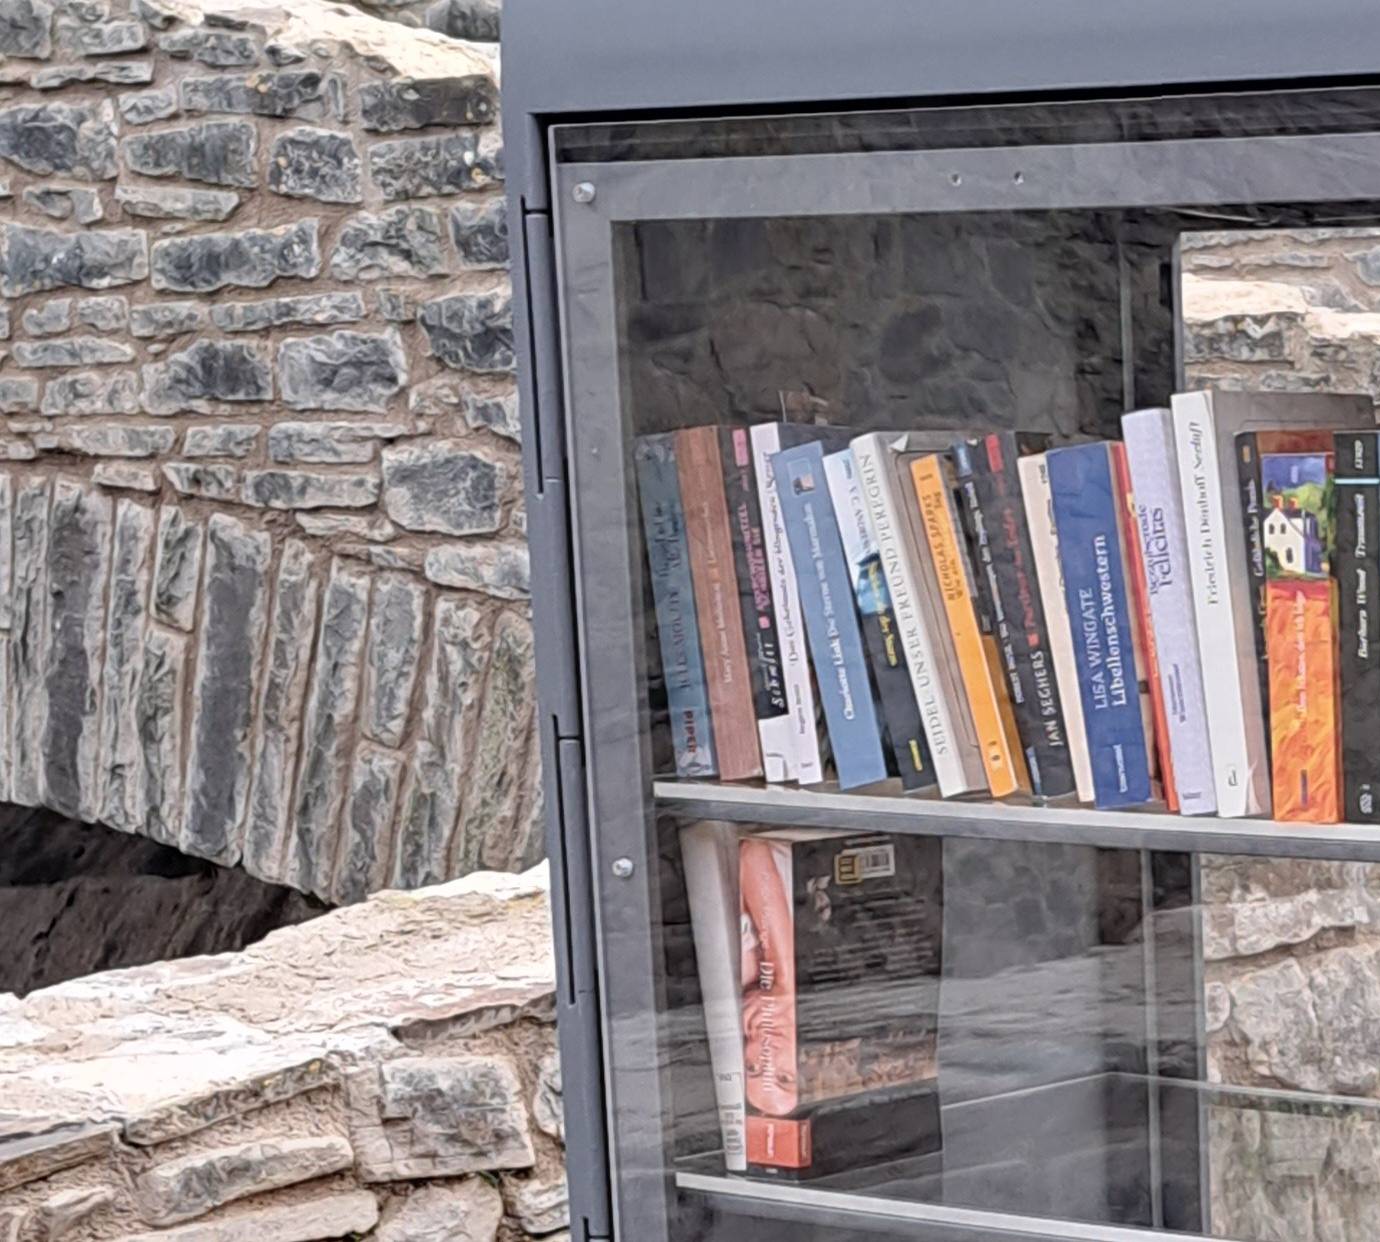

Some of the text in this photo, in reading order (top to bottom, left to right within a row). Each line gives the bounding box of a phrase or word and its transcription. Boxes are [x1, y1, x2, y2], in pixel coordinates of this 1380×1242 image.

[860, 455, 891, 541] PEREGRIN
[886, 548, 913, 620] FREUND
[934, 543, 956, 602] NICHOLAS
[1202, 538, 1218, 604] Friedrich
[1079, 589, 1108, 709] LISA WINGATE
[1095, 536, 1126, 705] Libellenschwestern
[907, 627, 930, 687] UNSER
[838, 668, 854, 720] Charlotte
[925, 696, 947, 755] SEIDEL
[1031, 651, 1063, 746] JAN SEGHERS
[758, 961, 775, 989] Die
